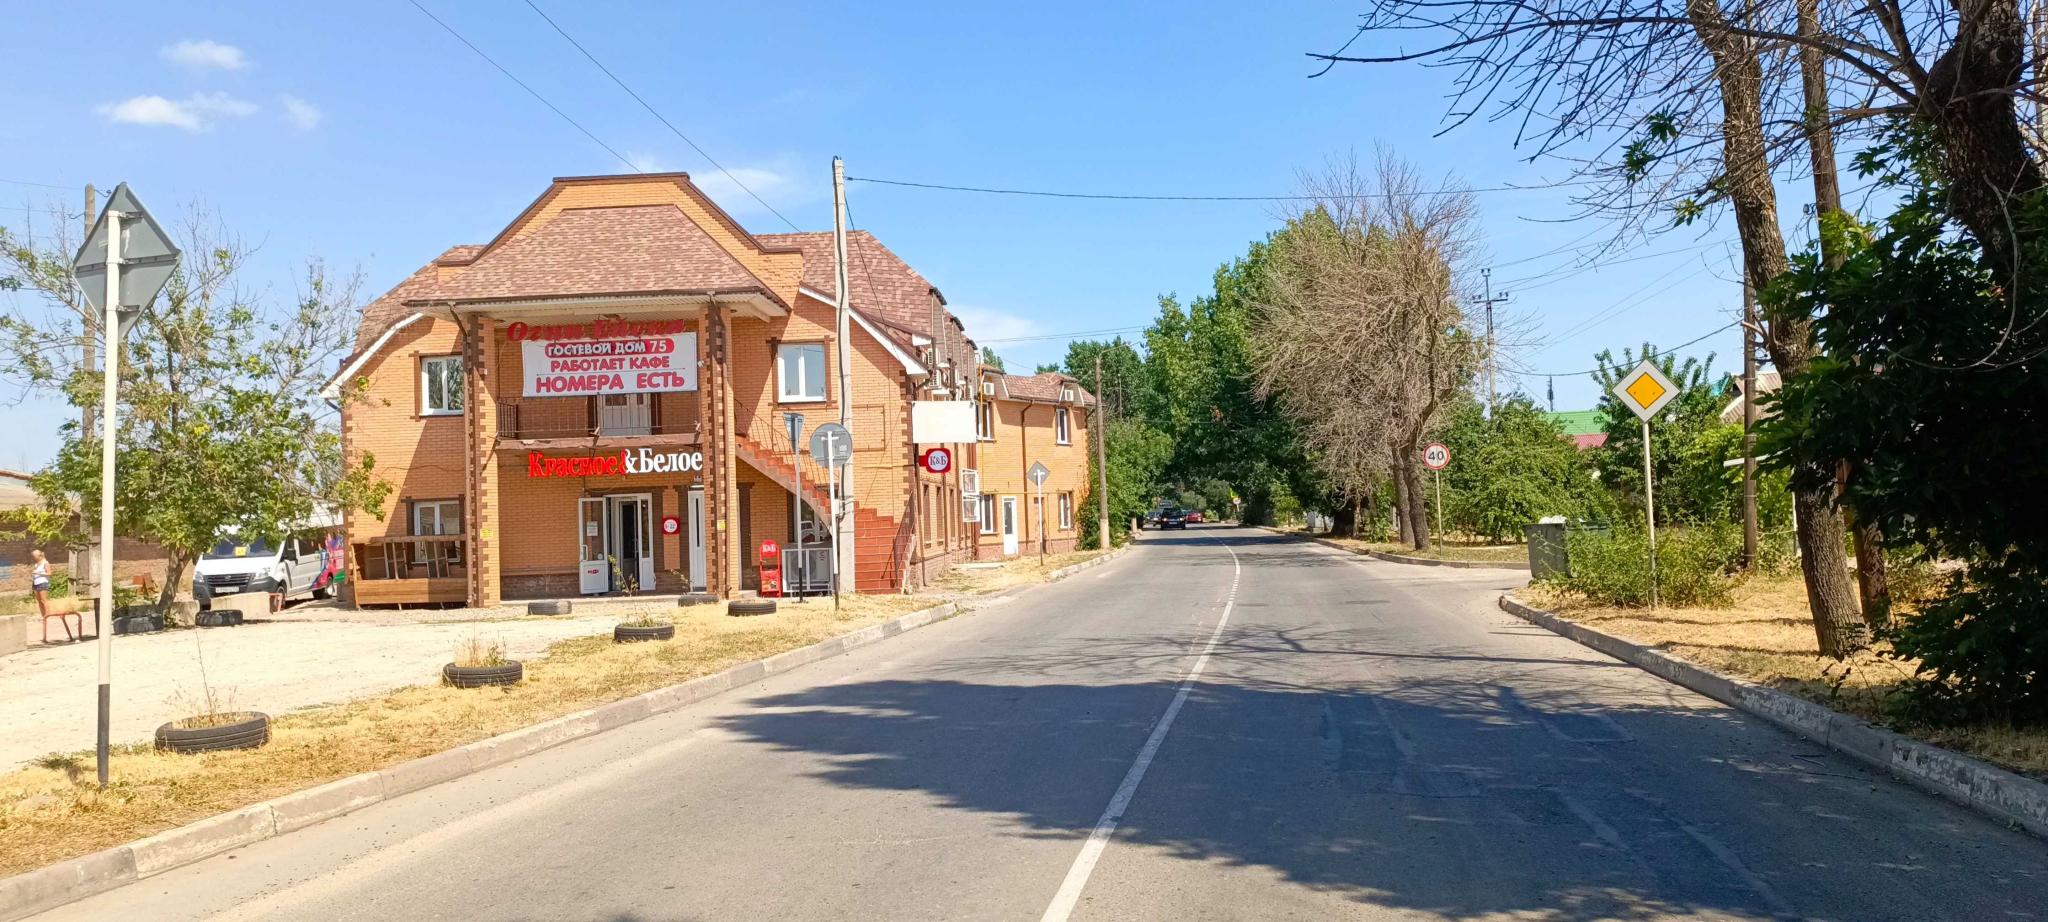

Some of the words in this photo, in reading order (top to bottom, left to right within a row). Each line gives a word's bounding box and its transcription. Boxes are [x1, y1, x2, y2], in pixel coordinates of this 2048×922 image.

[548, 342, 612, 356] ГОСТЕВОЙ
[614, 341, 645, 354] ДОМ
[650, 340, 667, 352] 75
[551, 357, 625, 372] РАБОТАЕТ
[629, 356, 670, 369] КАФЕ
[536, 374, 624, 393] НОМЕРА
[636, 372, 685, 388] ЕСТЬ
[929, 455, 947, 466] К&Б
[1428, 451, 1444, 460] 40
